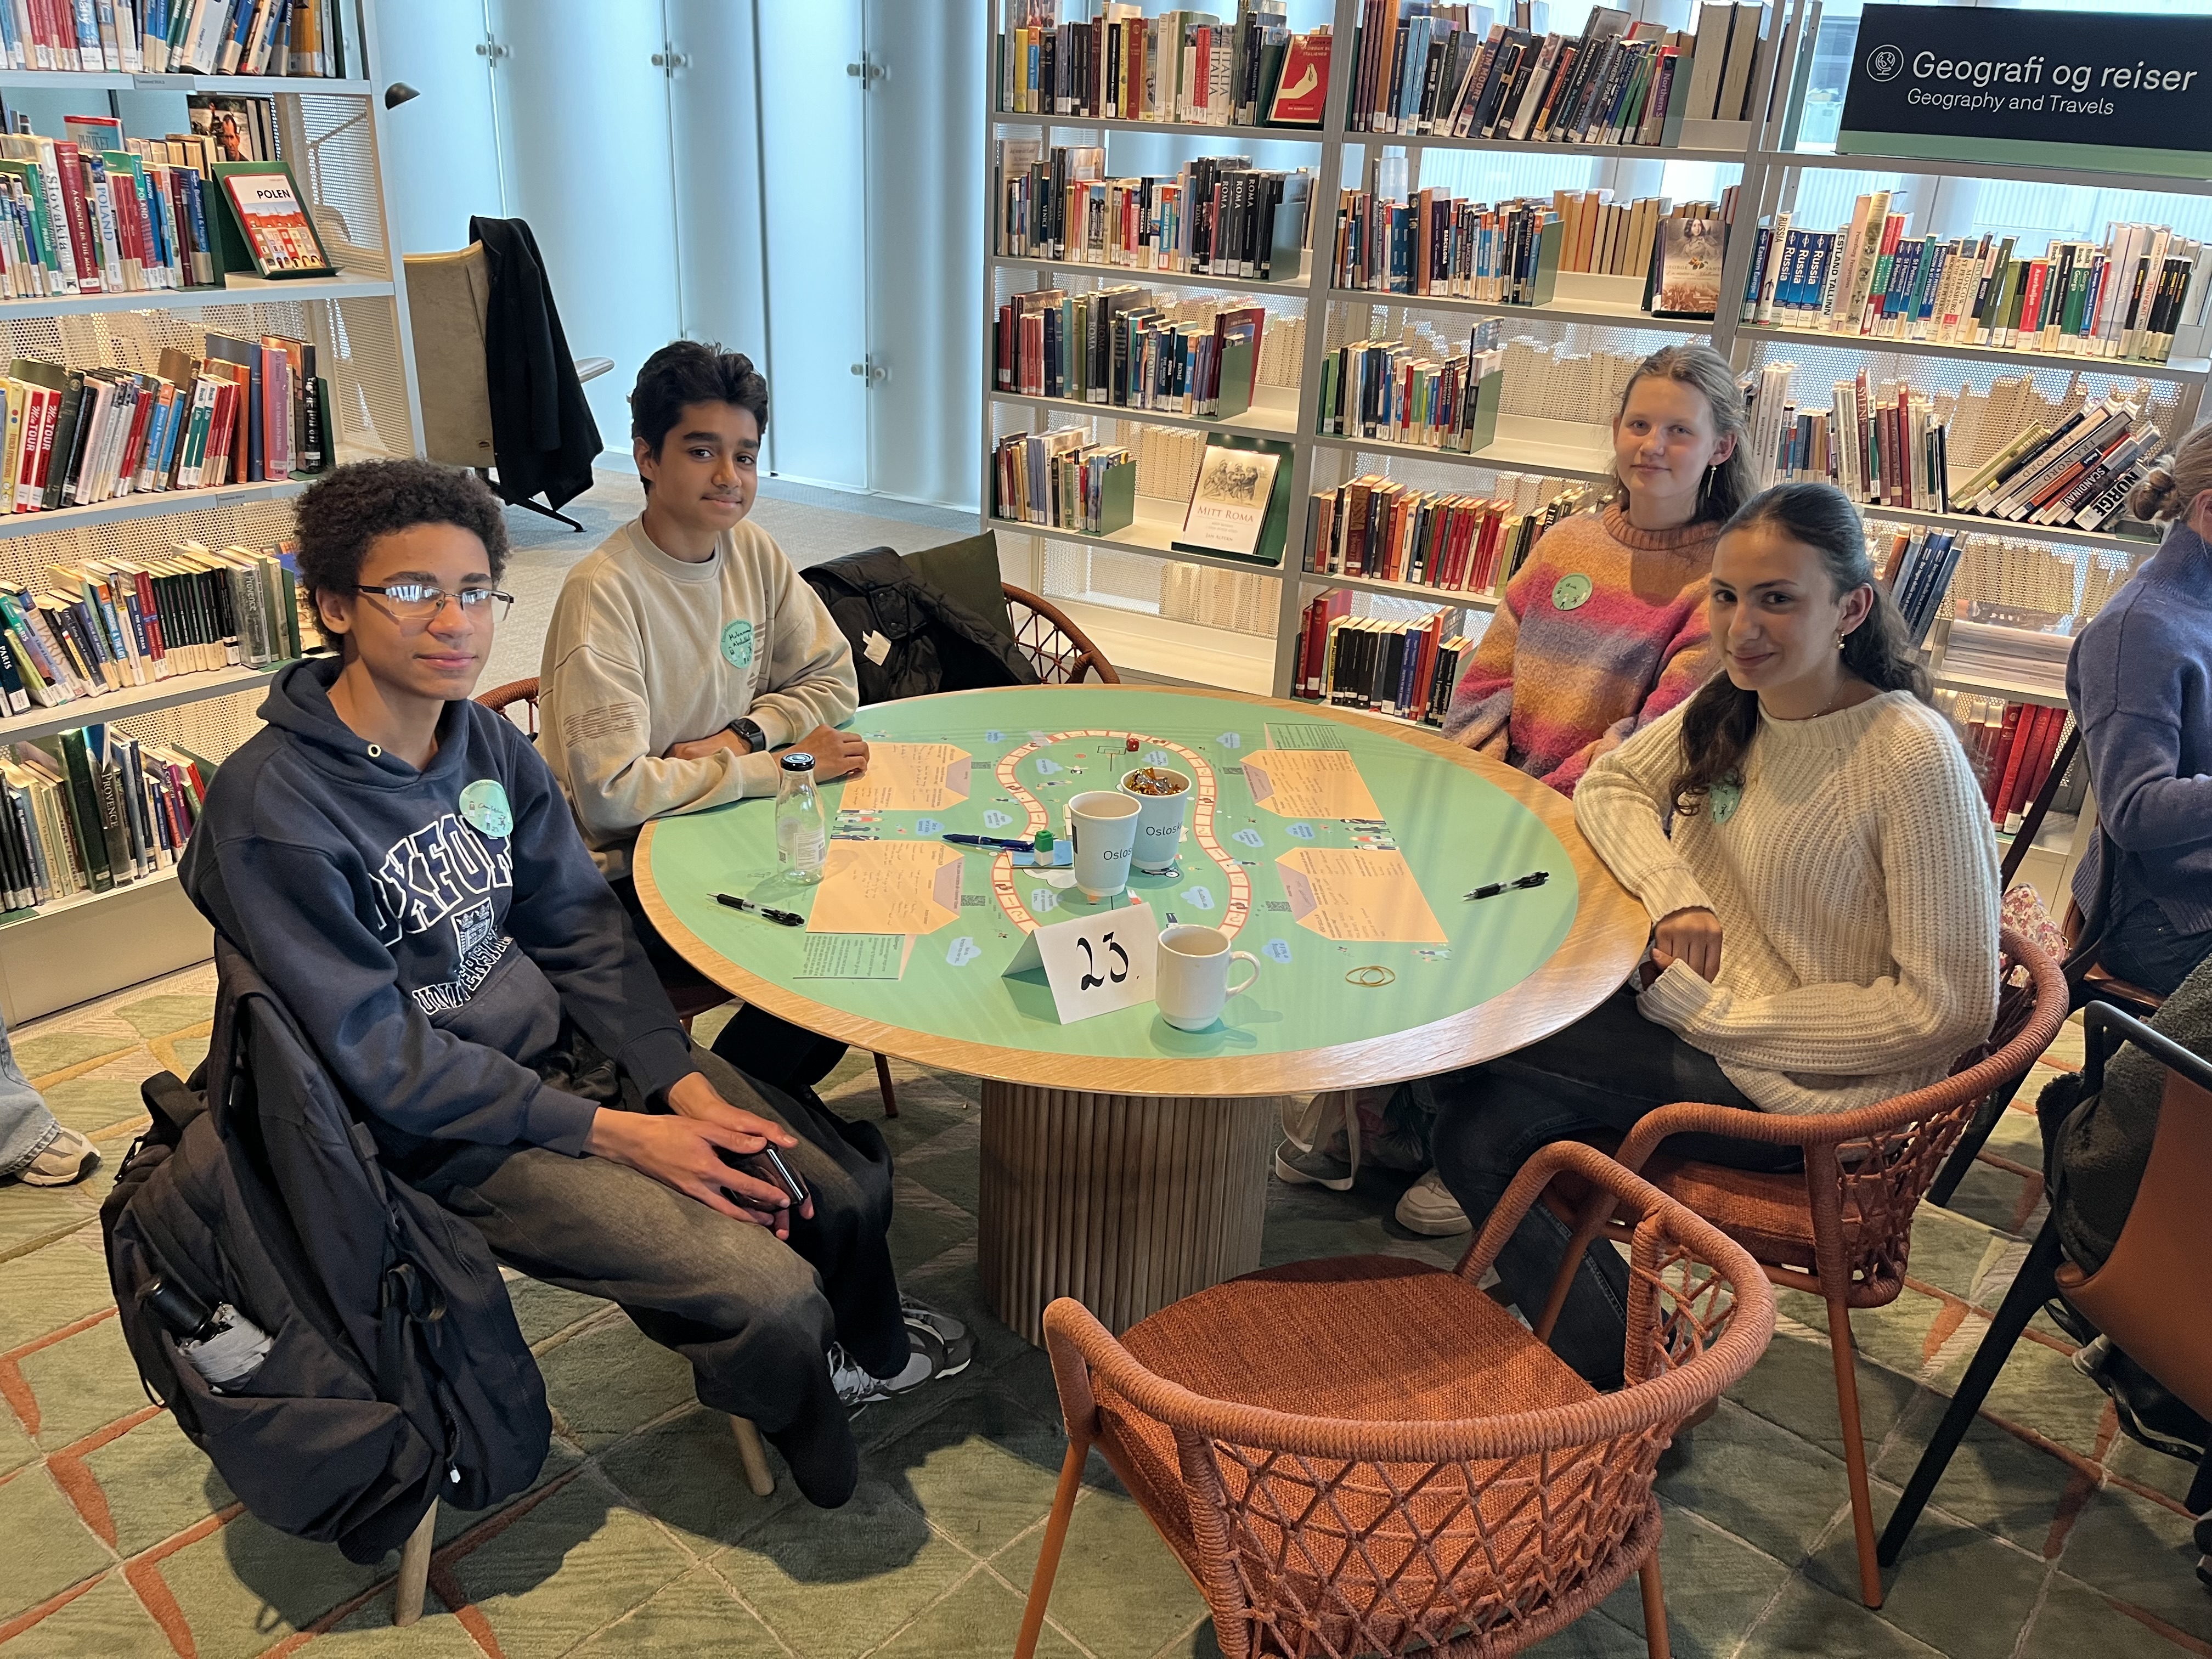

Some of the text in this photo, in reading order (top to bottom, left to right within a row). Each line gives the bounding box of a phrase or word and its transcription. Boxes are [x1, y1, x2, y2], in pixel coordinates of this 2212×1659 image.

[1209, 50, 1220, 96] ITALIA
[1220, 51, 1231, 97] ITALIA
[1470, 47, 1496, 101] TIM MOORE
[1601, 49, 1624, 101] NORTHERN SPAIN
[1621, 53, 1639, 88] Pyrenees
[1912, 50, 2198, 93] Geografi og reiser
[1655, 72, 1672, 111] Northern
[1907, 88, 2114, 115] Geography and Travels
[78, 134, 109, 150] PHUKET
[136, 187, 150, 219] POLAND
[192, 189, 204, 219] Budapest
[256, 189, 291, 200] POLEN
[1220, 180, 1229, 208] ROMA
[1233, 180, 1243, 208] ROMA
[1245, 178, 1256, 207] ROMA
[45, 173, 70, 251] Slovakia
[73, 196, 84, 230] COUNTRY
[93, 187, 116, 241] POLAND
[79, 231, 87, 241] IN
[197, 225, 208, 252] Hungary
[1523, 218, 1533, 256] Mallorca
[1775, 217, 1787, 242] RUSSIA
[81, 242, 89, 256] THE
[1844, 231, 1861, 288] Petersburg Perspectives
[1931, 246, 1940, 267] MOSCOW
[1937, 246, 1946, 267] MOSCOW
[83, 256, 93, 279] MOON
[1750, 246, 1764, 293] Eastern Europe
[1780, 247, 1795, 281] Russia
[1793, 250, 1809, 284] Russia
[1808, 250, 1824, 285] Russia
[1824, 235, 1845, 315] ESTLAND TALLINN
[1887, 263, 1900, 292] Petersburg
[1895, 264, 1908, 293] Petersburg
[1903, 265, 1916, 296] Petersburg
[1921, 278, 1932, 304] PETERSBURG
[1927, 278, 1939, 305] PETERSBURG
[1947, 275, 1956, 297] GOLDEN
[1949, 258, 1968, 314] ST PETERSBURG
[1958, 268, 1972, 305] MOSCOW
[1968, 261, 1983, 299] MOSCOW
[1979, 280, 1988, 299] MOSCOW
[2027, 268, 2041, 306] Azerbaijan
[2045, 268, 2054, 290] Armenia
[2140, 242, 2162, 316] UKRAINE WEST-EAST
[1934, 290, 1947, 324] PETERSBURG
[1087, 322, 1096, 350] ROMA
[1097, 324, 1106, 352] ROMA
[26, 424, 38, 451] TOUR
[41, 423, 54, 450] TOUR
[2074, 439, 2095, 459] FRA
[2021, 435, 2074, 479] FRA NORD
[2043, 456, 2074, 484] NORD
[2094, 469, 2140, 517] NORGE
[1198, 506, 1253, 522] MITT ROMA
[244, 575, 258, 611] Provence
[14, 622, 29, 642] PARIS
[36, 623, 67, 668] PARIS
[114, 636, 123, 648] THE
[0, 646, 12, 669] PARIS
[116, 647, 126, 658] LOT
[101, 772, 120, 828] PROVENCE
